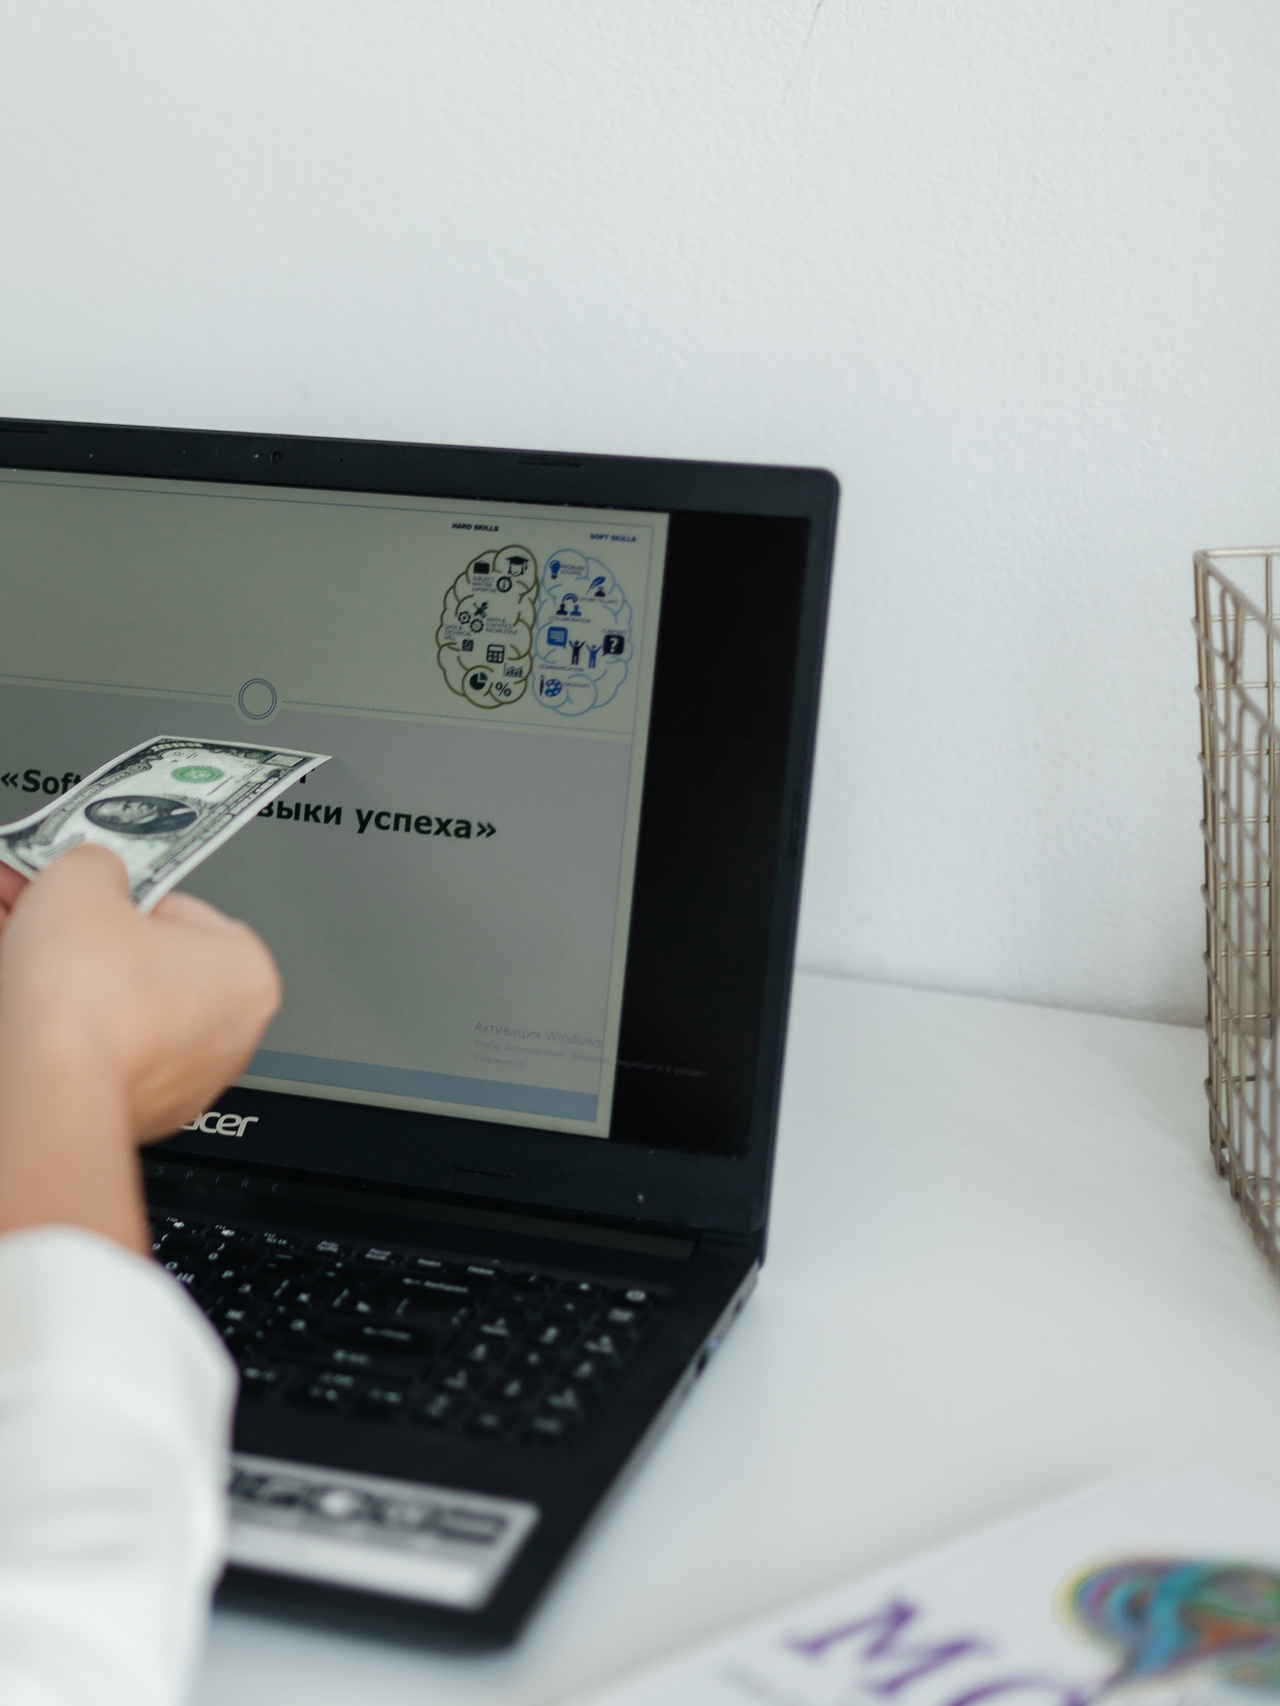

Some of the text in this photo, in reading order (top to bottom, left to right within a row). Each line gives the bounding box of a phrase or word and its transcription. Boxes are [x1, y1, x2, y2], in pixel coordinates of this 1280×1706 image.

[452, 522, 499, 532] HARD SKILLS
[590, 533, 637, 543] SOFT SKILLS
[257, 800, 497, 839] выки успеха»
[474, 1021, 602, 1048] Активация Windows
